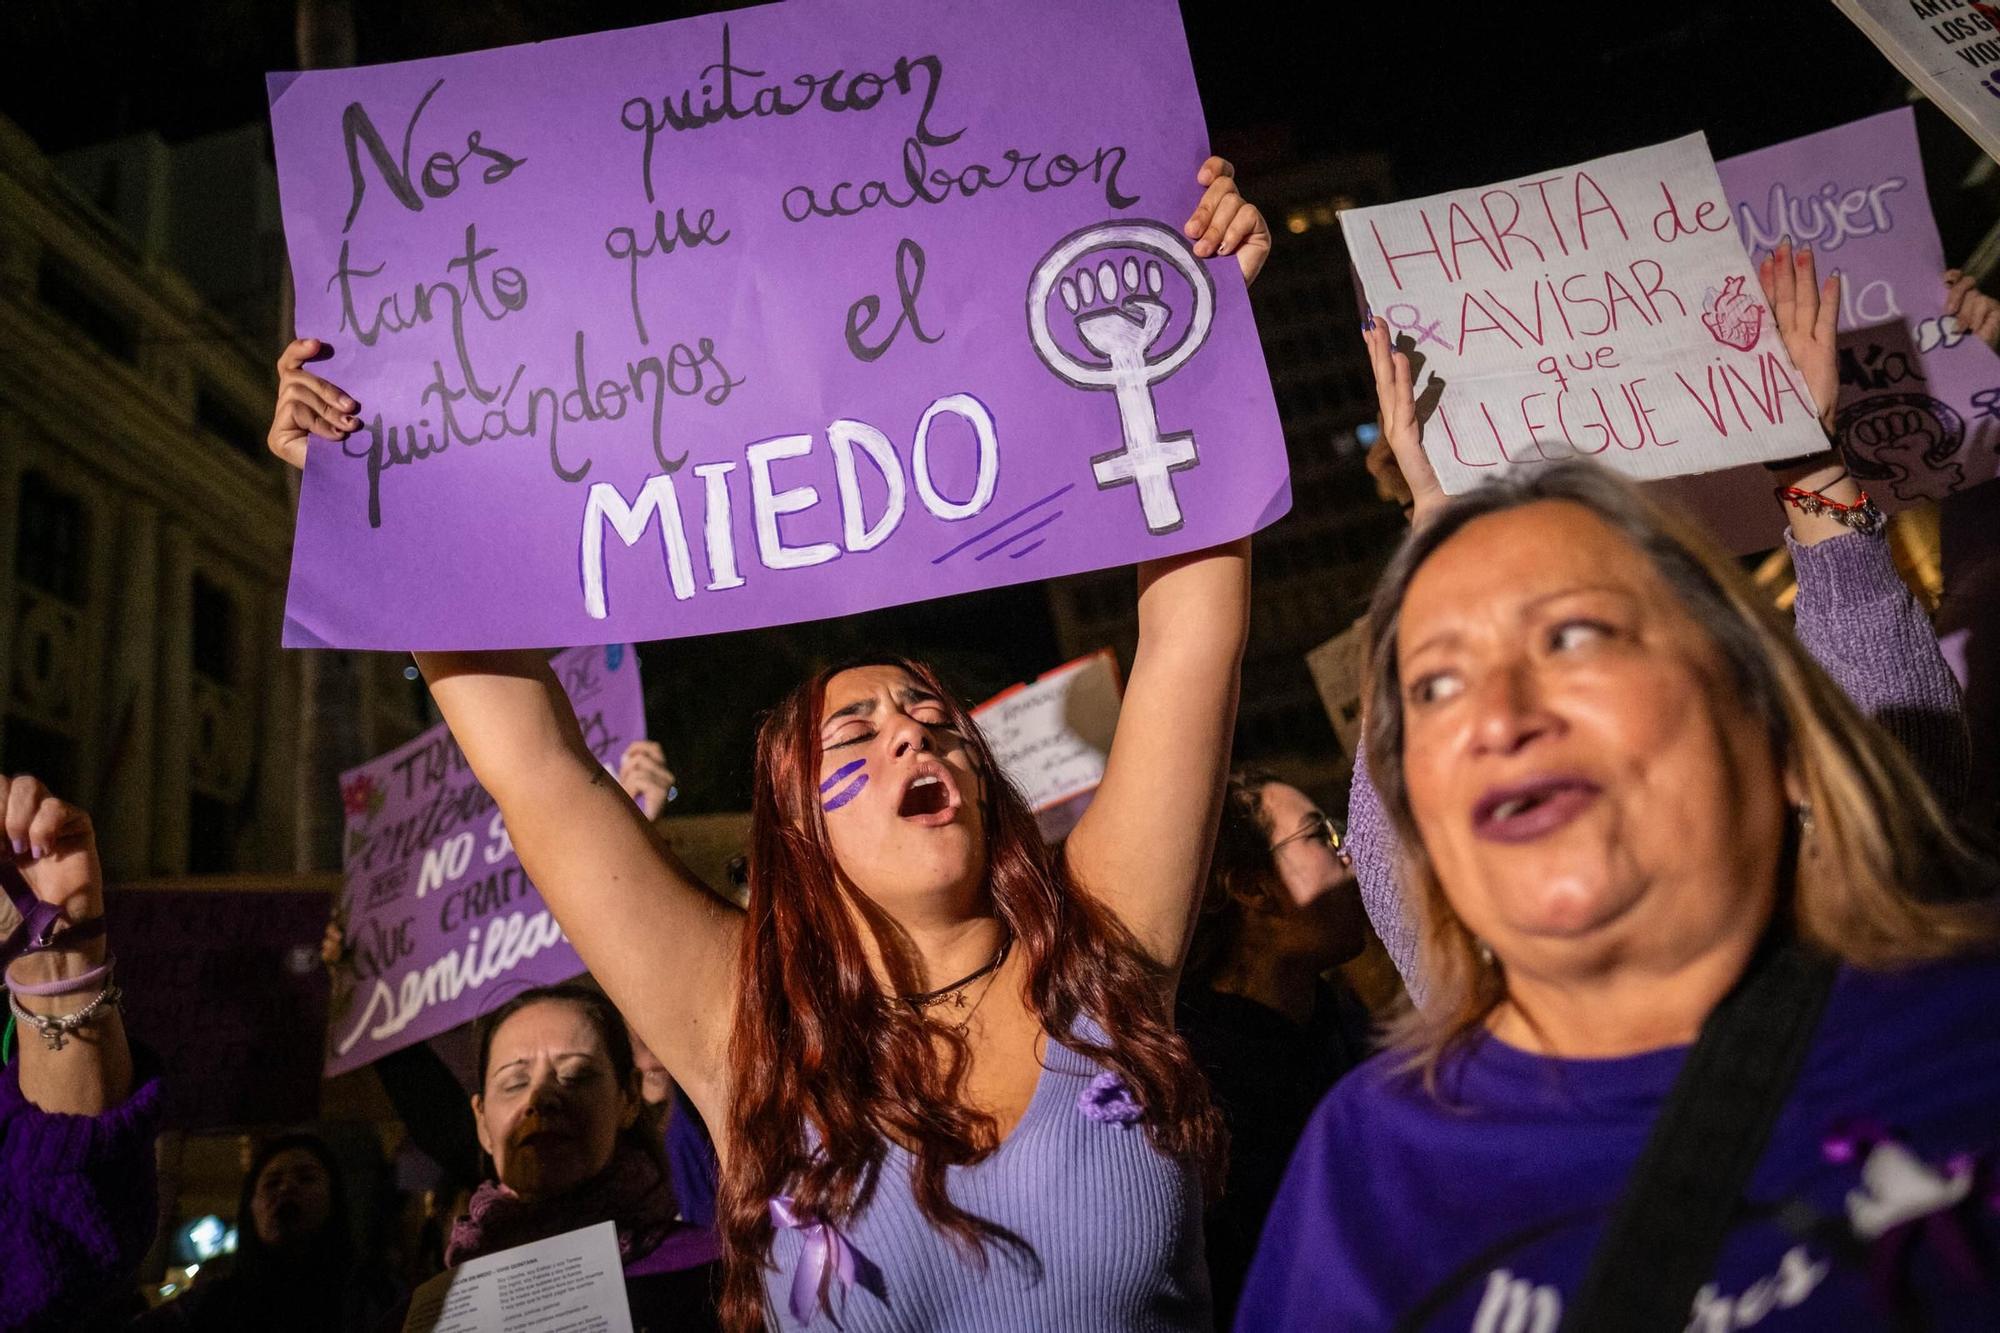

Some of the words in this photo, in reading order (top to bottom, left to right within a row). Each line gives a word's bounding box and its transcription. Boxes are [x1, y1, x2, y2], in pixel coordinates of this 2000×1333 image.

[1930, 16, 1978, 44] LOS
[343, 78, 528, 234] Nos
[621, 22, 967, 203] quitaron
[327, 223, 528, 404] tanto
[605, 206, 731, 345] que
[782, 137, 1141, 222] acabaron
[1370, 171, 1629, 290] HARTA
[1653, 181, 1731, 243] de
[1738, 178, 1907, 256] Mujer
[343, 330, 747, 528] quitándonos
[844, 238, 946, 363] el
[1439, 376, 1680, 467] LLEGUE
[1537, 346, 1621, 392] que
[578, 392, 1001, 619] MIEDO
[416, 831, 475, 898] NO
[339, 910, 571, 1056] semilla
